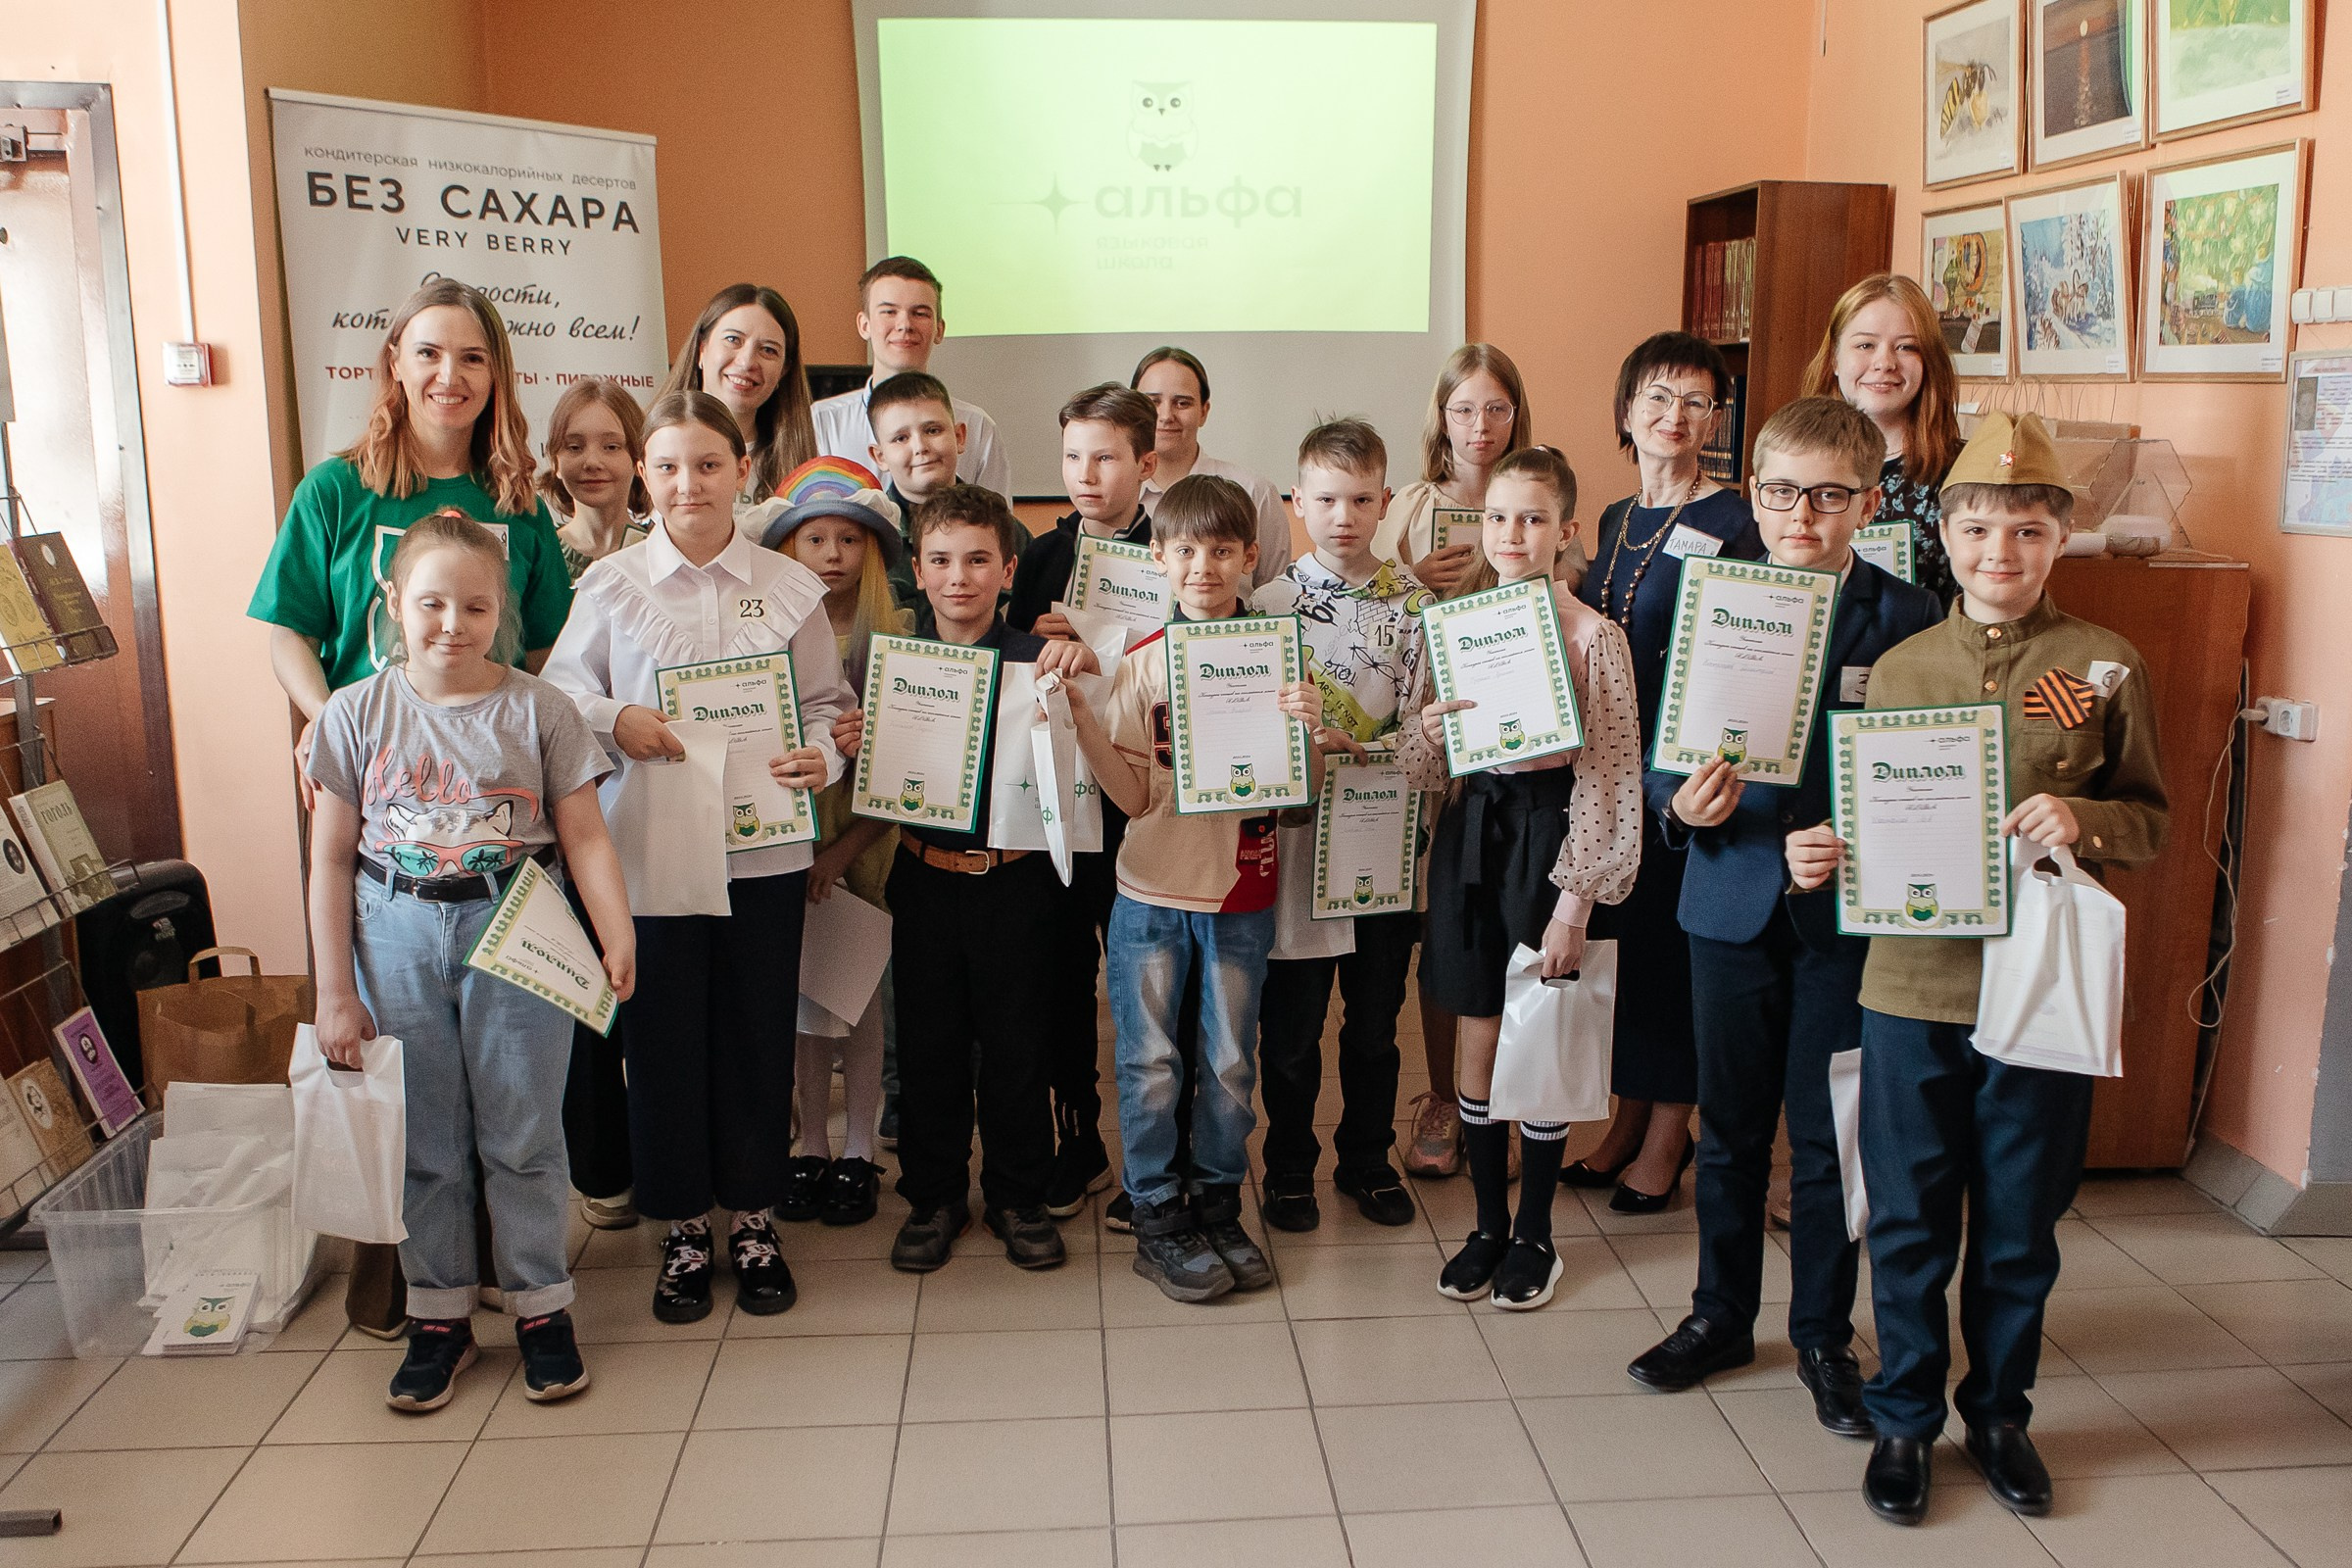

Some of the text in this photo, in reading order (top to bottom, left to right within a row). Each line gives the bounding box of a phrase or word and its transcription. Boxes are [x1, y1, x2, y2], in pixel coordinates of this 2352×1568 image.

[304, 147, 636, 190] кондитерская низкокалорийных десертов
[307, 171, 640, 234] БЕЗ САХАРА
[1095, 174, 1302, 229] альфа
[395, 226, 571, 255] VERY BERRY
[507, 316, 641, 341] жно всем!
[324, 366, 374, 380] ТОРТ
[1669, 538, 1708, 555] ТАМАРА
[1099, 578, 1159, 603] Диплом
[739, 599, 765, 618] 23
[1711, 608, 1793, 635] Диплом
[1374, 624, 1396, 647] 15
[1458, 626, 1528, 651] Диплом
[1199, 662, 1271, 680] Диплом
[893, 677, 960, 702] Диплом
[693, 702, 766, 722] Диплом
[1316, 680, 1335, 698] ART
[1343, 710, 1358, 727] NOT
[1871, 760, 1965, 781] Диплом
[1343, 787, 1398, 803] Диплом
[40, 803, 74, 825] ГОГОЛЬ
[522, 939, 590, 990] Диплом
